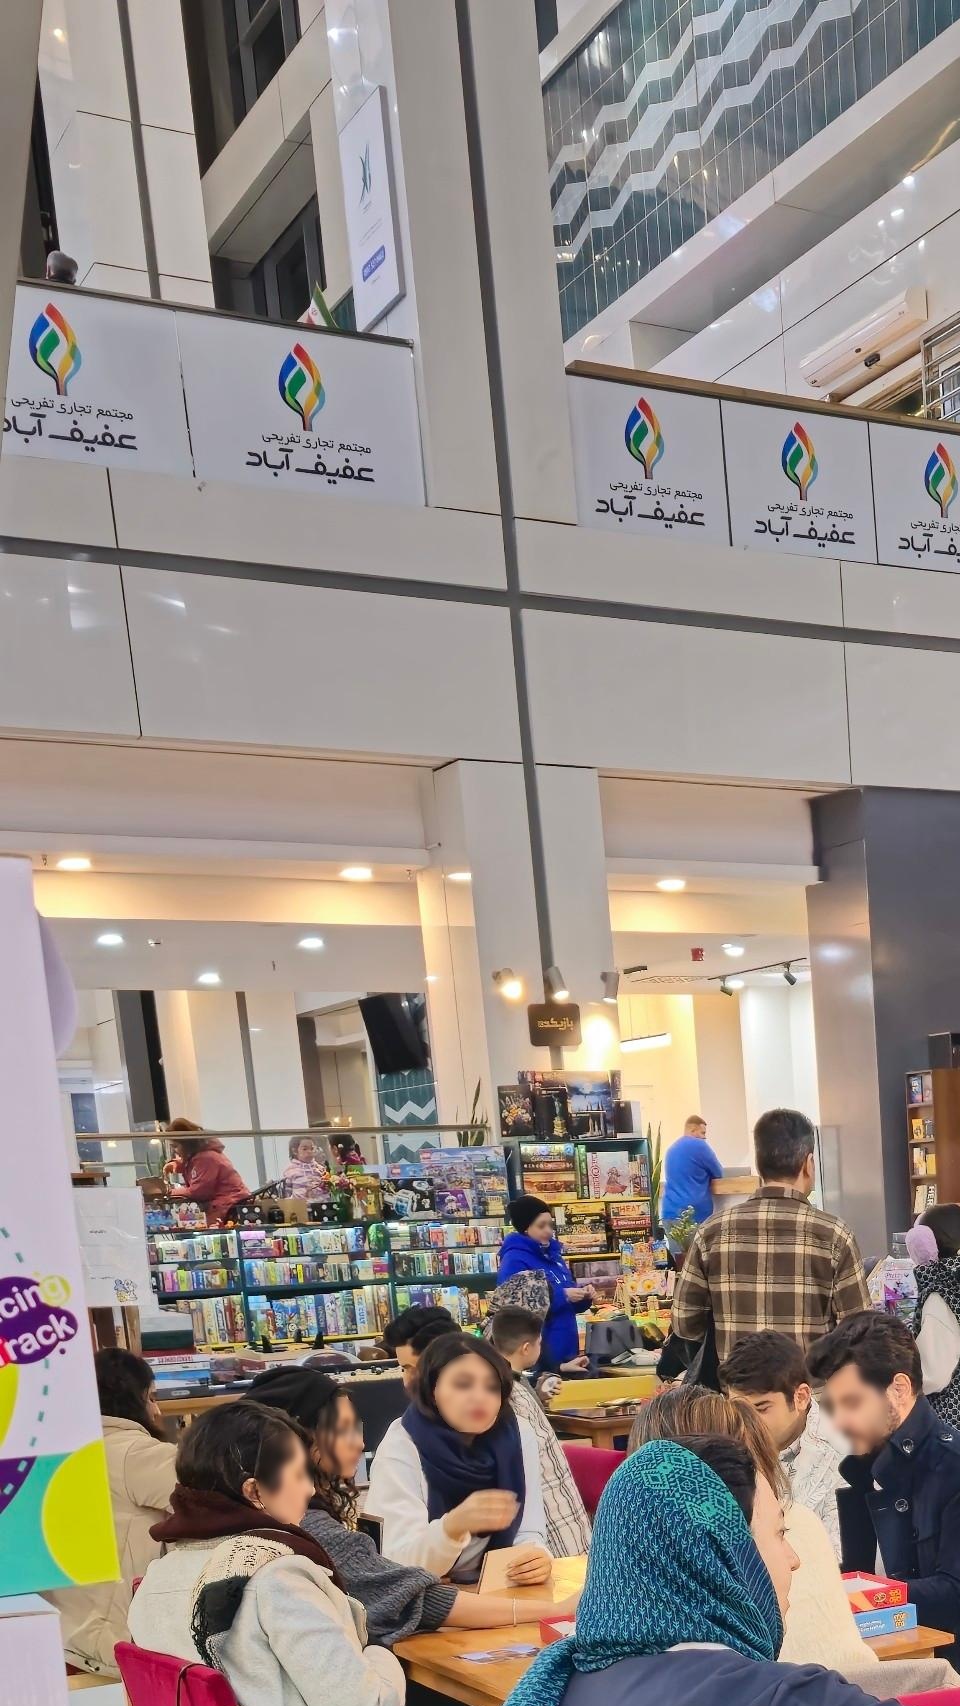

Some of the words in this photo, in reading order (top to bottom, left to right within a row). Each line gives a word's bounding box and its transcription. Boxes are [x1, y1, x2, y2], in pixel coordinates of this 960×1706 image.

[11, 397, 54, 410] تفریحی
[56, 402, 92, 416] تجاری
[96, 408, 134, 422] مجتمع
[48, 420, 138, 452] عفیف
[262, 433, 301, 446] تفریحی
[302, 437, 334, 451] تجاری
[338, 442, 371, 456] مجتمع
[245, 447, 294, 477] آباد
[295, 454, 375, 484] عفیف
[609, 480, 643, 493] تفریحی
[644, 485, 671, 497] تجاری
[674, 488, 703, 502] مجتمع
[595, 495, 637, 522] آباد
[767, 501, 798, 513] تفریحی
[800, 505, 824, 517] تجاری
[637, 500, 705, 529] عفیف
[827, 508, 854, 521] مجتمع
[754, 516, 792, 542] آباد
[911, 520, 939, 531] تفریحی
[793, 520, 856, 548] عفیف
[898, 533, 933, 558] آباد
[0, 1275, 70, 1323] cing
